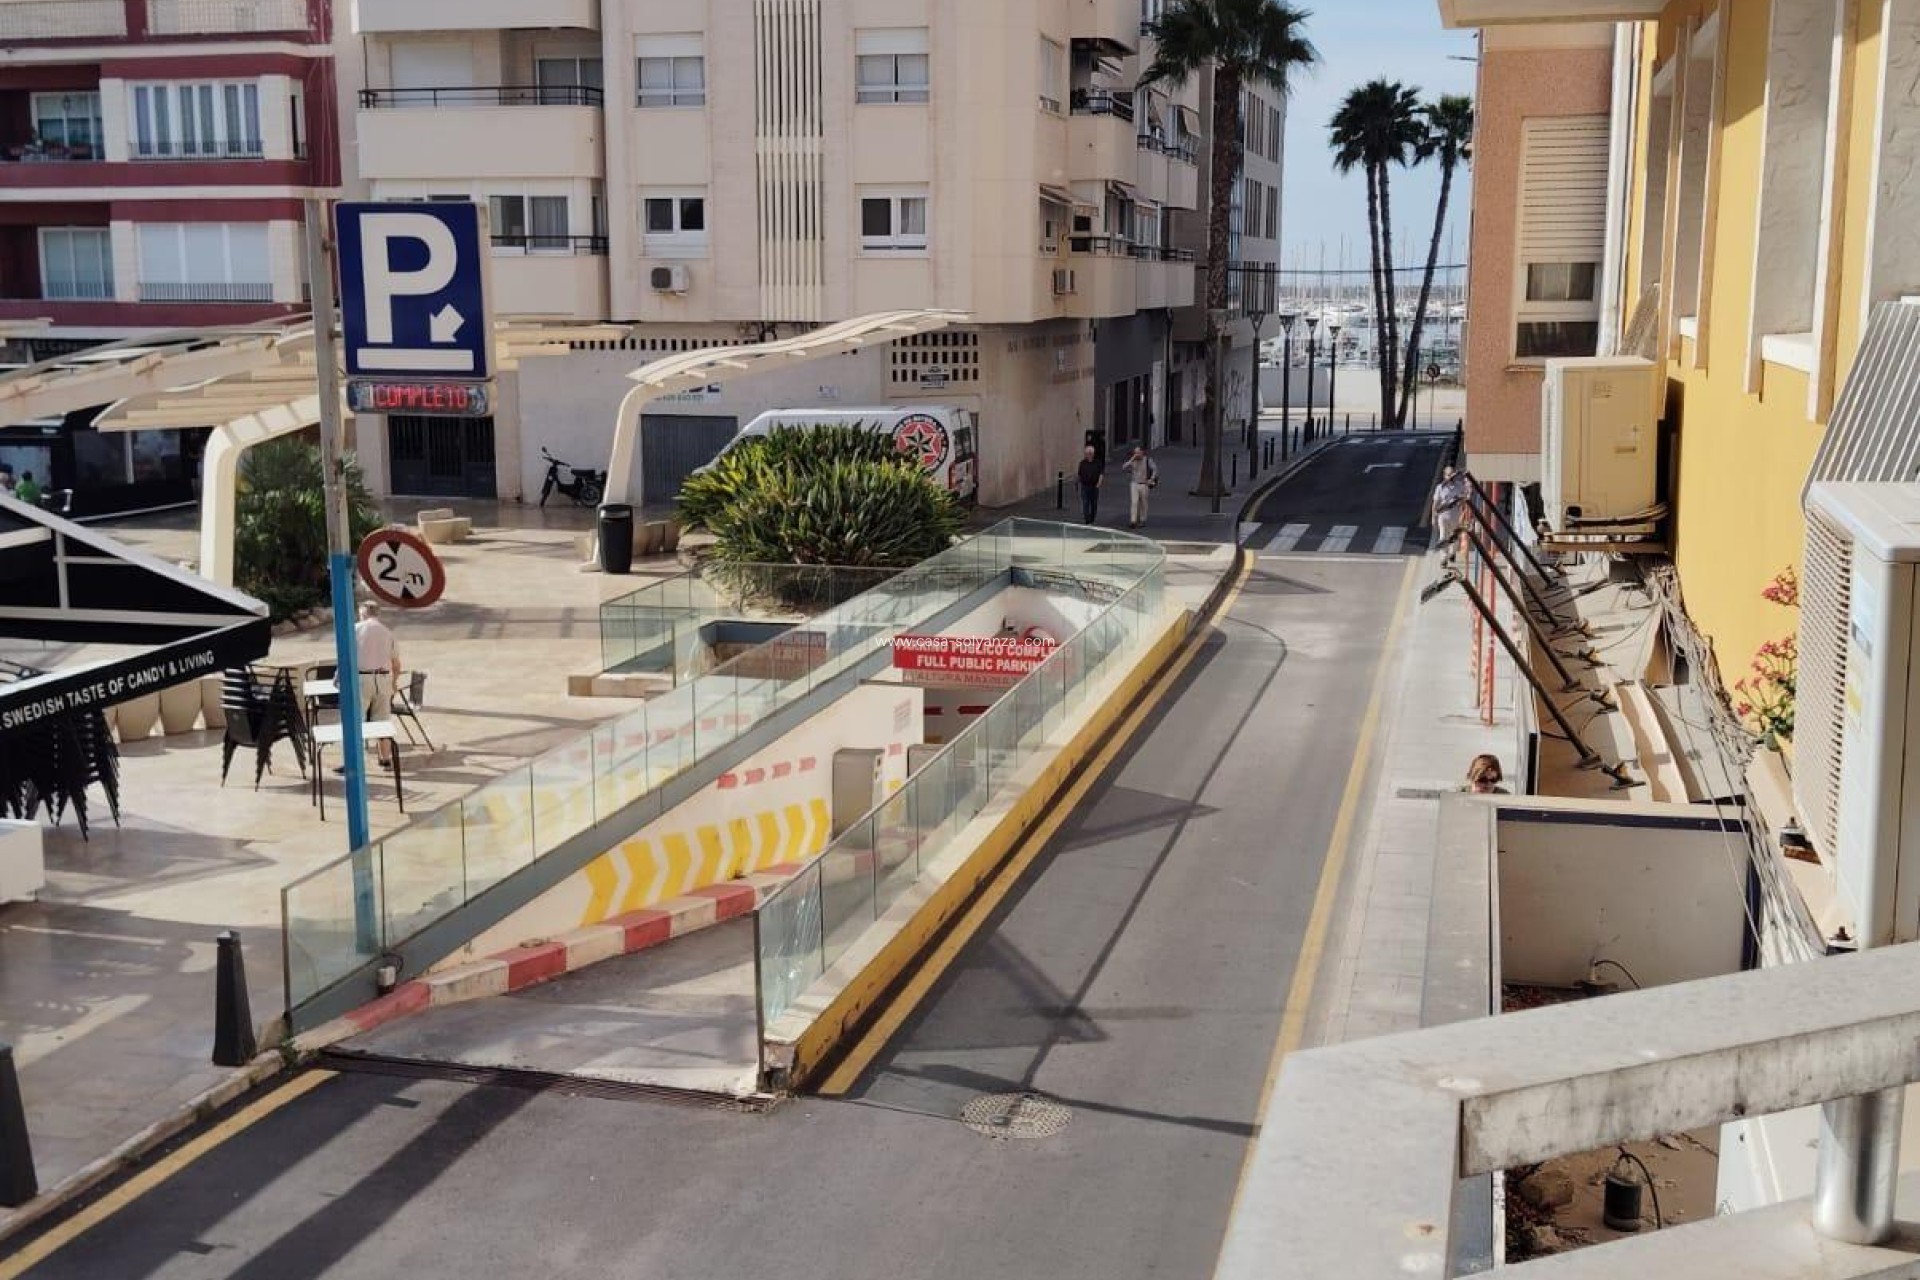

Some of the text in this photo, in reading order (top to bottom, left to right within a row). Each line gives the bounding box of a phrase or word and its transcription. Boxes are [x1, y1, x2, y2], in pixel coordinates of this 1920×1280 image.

[359, 212, 457, 343] P
[374, 384, 468, 410] COMPLETO
[376, 553, 400, 582] 2
[916, 654, 947, 668] FULL
[950, 656, 994, 671] PUBLIC
[3, 649, 215, 728] SWEDISH TASTE OF CANDY & LIVING
